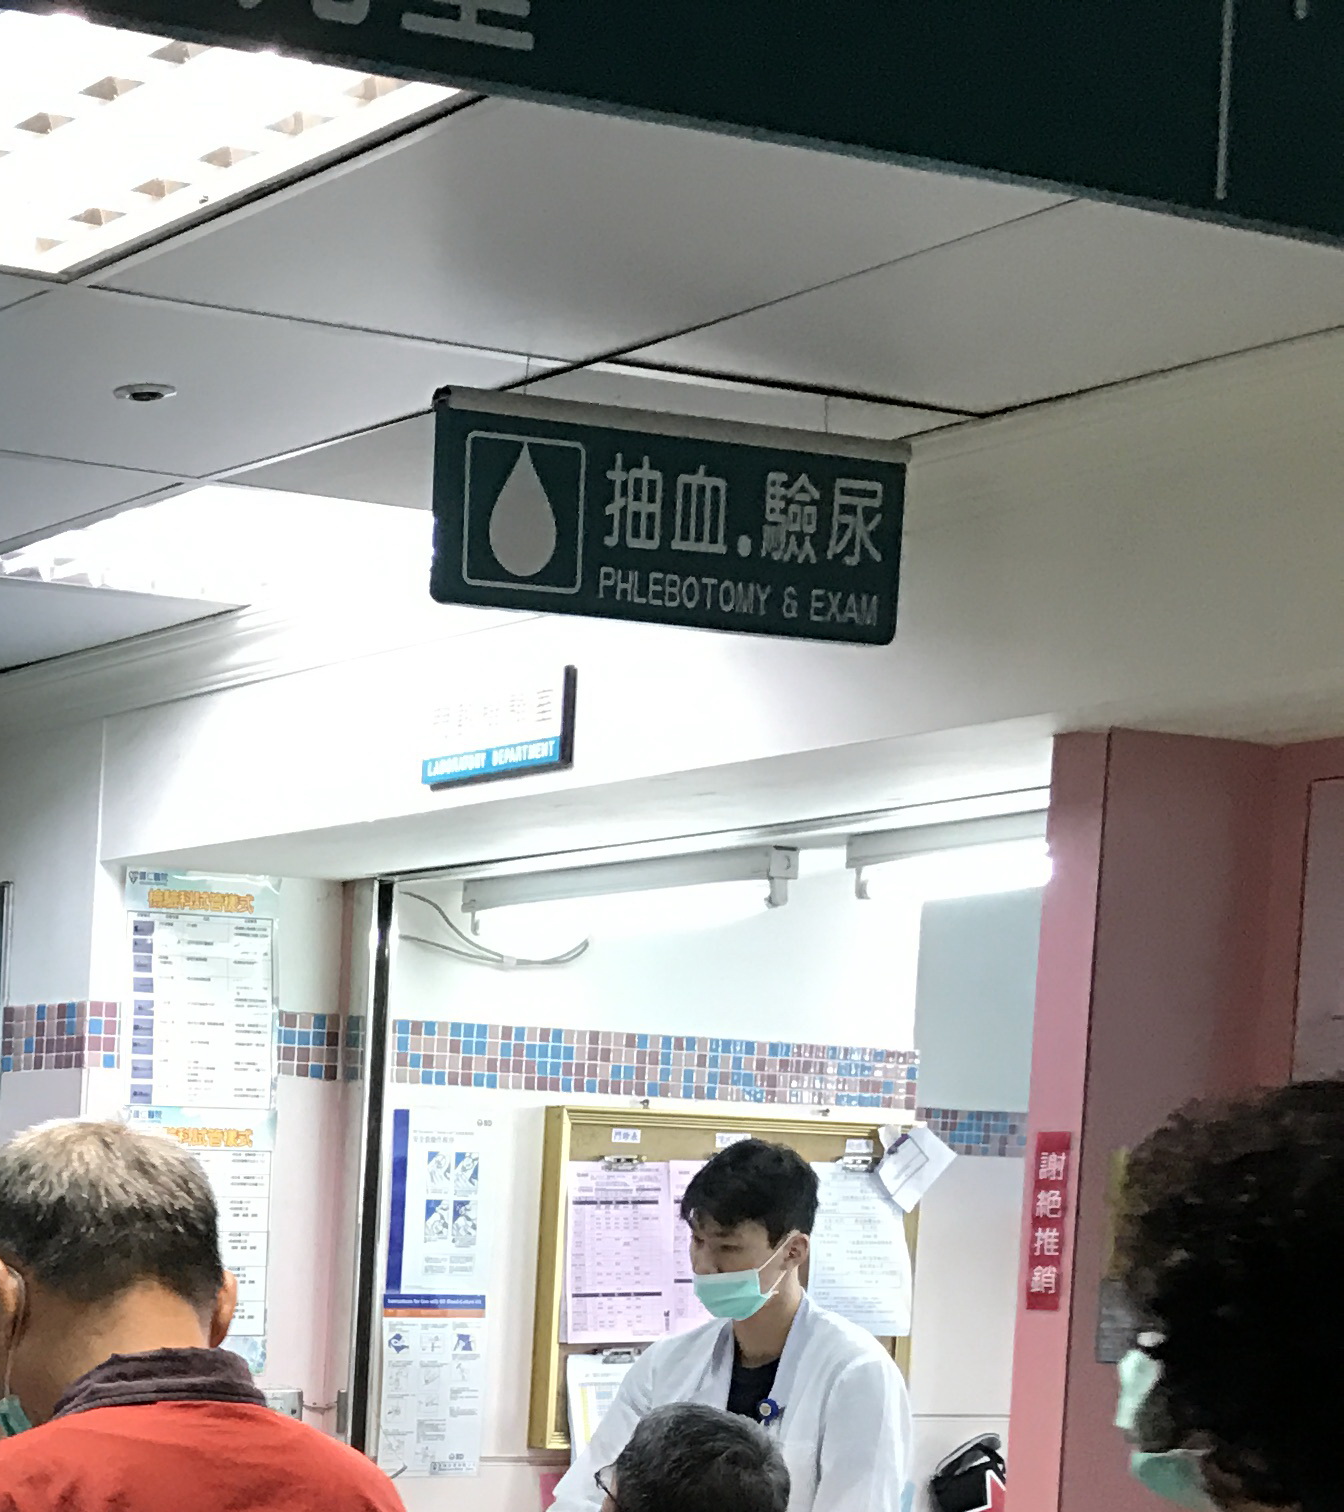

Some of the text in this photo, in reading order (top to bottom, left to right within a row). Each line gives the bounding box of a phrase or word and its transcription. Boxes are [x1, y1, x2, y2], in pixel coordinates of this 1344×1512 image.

[598, 566, 879, 627] PHLEBOTOMY & EXAM
[1030, 1151, 1067, 1294] 謝絕推銷
